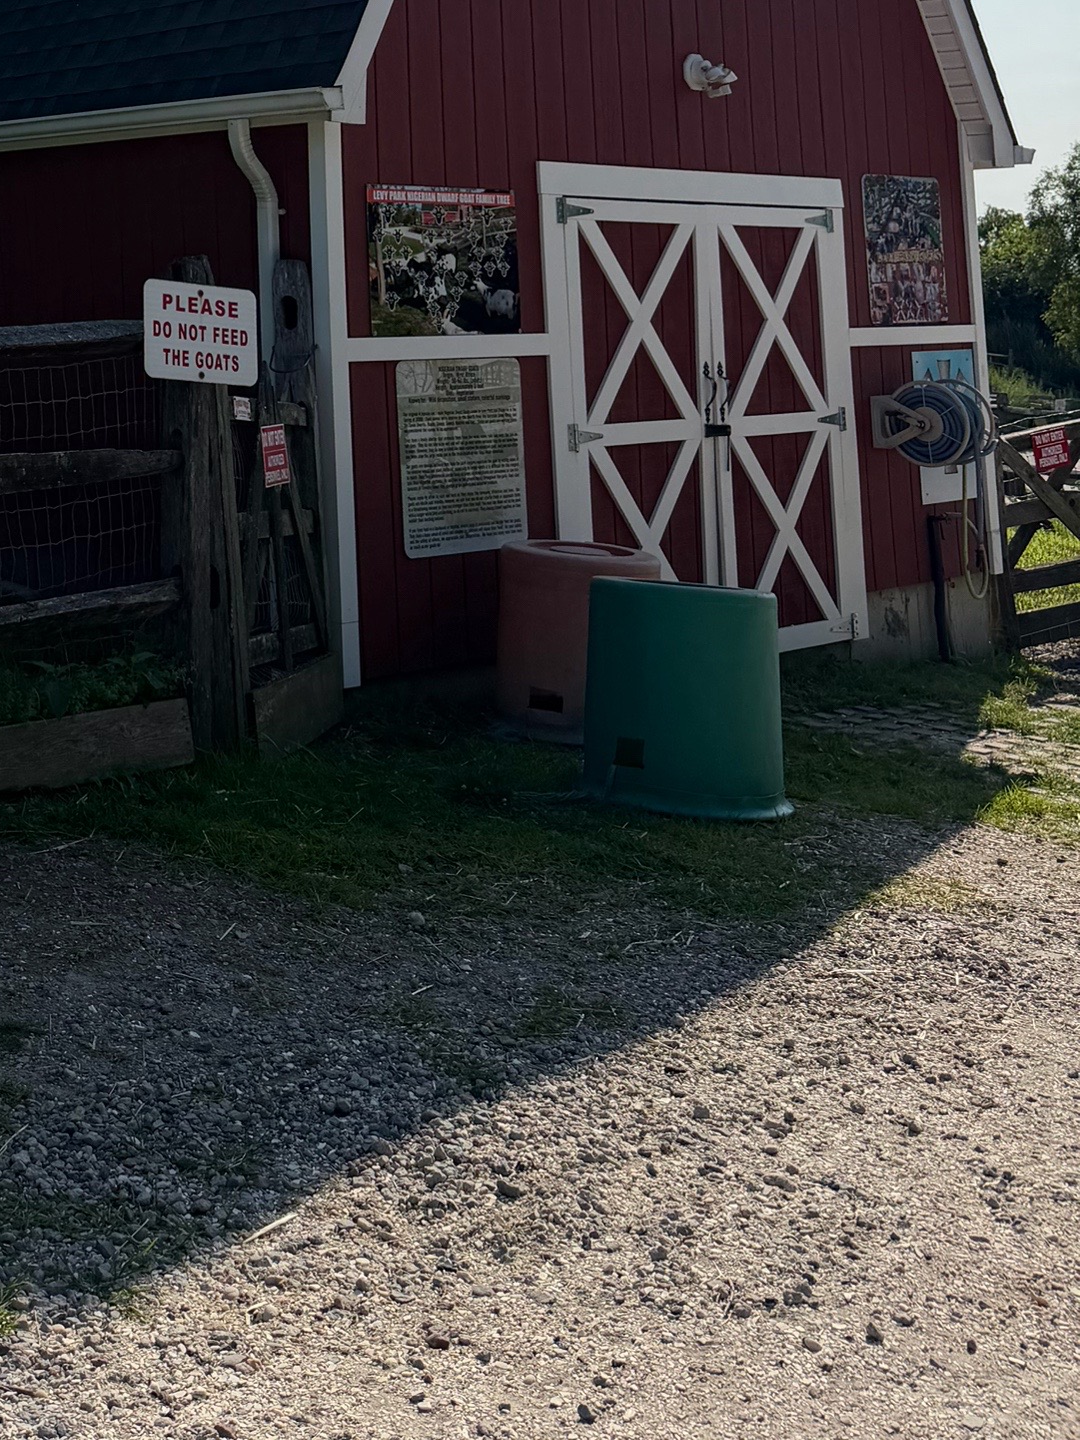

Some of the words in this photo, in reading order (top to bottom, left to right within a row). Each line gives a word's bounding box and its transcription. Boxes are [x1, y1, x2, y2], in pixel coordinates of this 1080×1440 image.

[373, 190, 388, 200] LEVY
[389, 191, 406, 202] PARK
[407, 192, 436, 202] NIGERIAN
[437, 192, 458, 203] DWARF
[460, 194, 474, 204] GOAT
[476, 194, 495, 204] FAMILY
[496, 194, 510, 205] TREE
[162, 294, 238, 318] PLEASE
[153, 320, 172, 338] DO
[178, 323, 206, 342] NOT
[213, 327, 248, 346] FEED
[163, 348, 189, 367] THE
[195, 351, 239, 372] GOATS
[1050, 430, 1064, 441] ENTER
